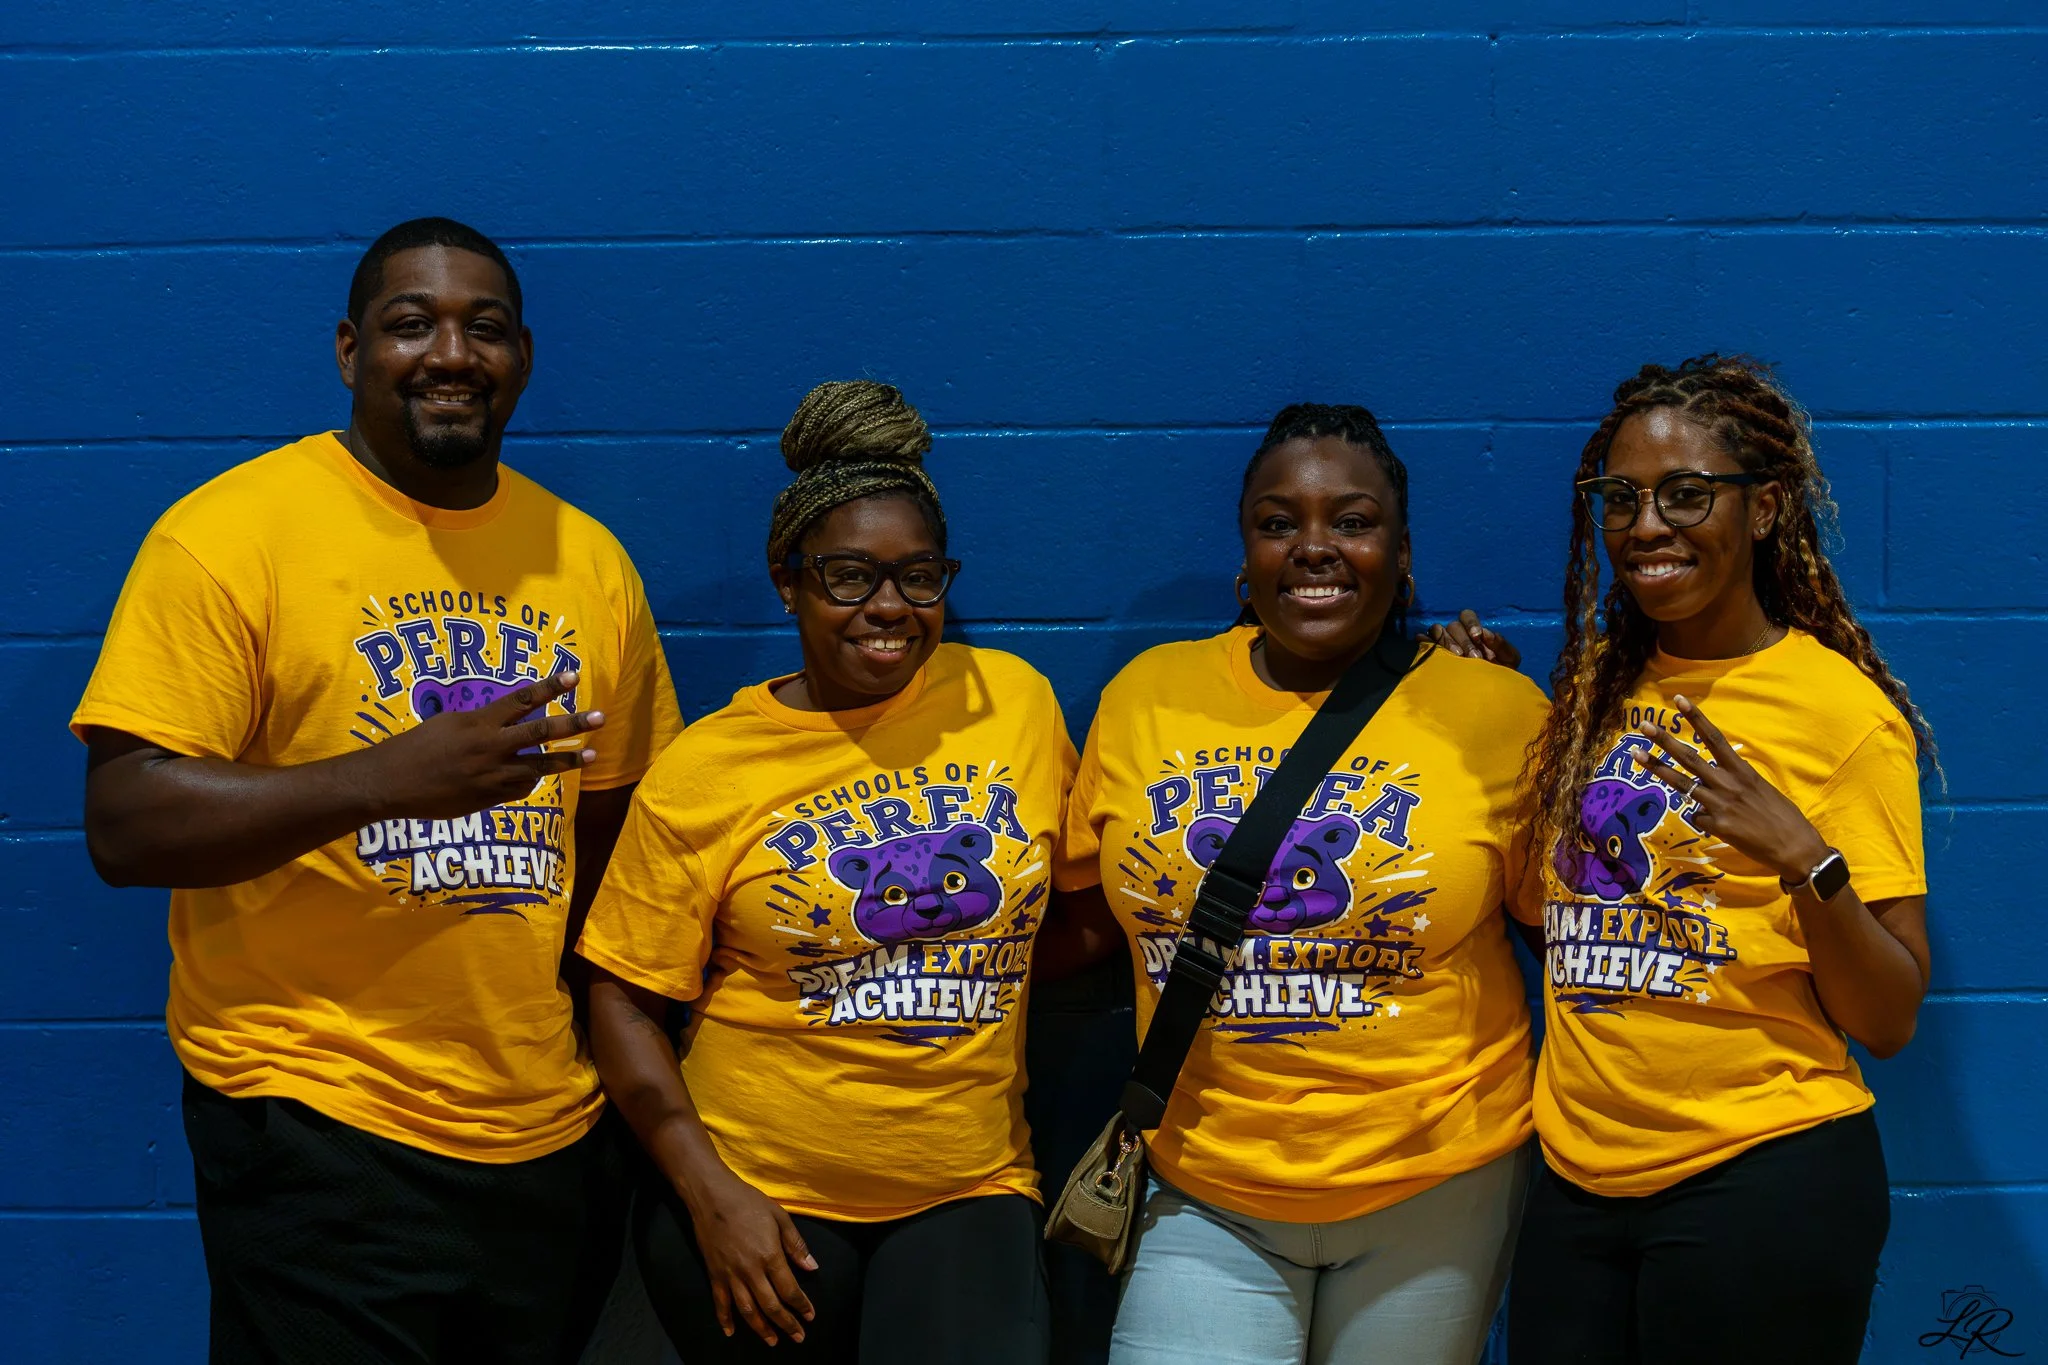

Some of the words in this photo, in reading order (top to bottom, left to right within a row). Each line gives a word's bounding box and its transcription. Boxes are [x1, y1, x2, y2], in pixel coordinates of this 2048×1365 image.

[389, 590, 507, 618] SCHOOLS
[521, 604, 549, 631] OF
[355, 617, 581, 714] PEREA
[1194, 746, 1294, 767] SCHO
[1350, 756, 1390, 775] OF
[794, 766, 929, 818] SCHOOLS
[945, 763, 979, 783] OF
[1146, 764, 1421, 849] PEEA
[764, 783, 1032, 871] PEREA
[1599, 907, 1737, 959] EXPLORE.
[831, 977, 1003, 1022] ACHIEVE.
[1204, 973, 1374, 1016] CHIEVE.
